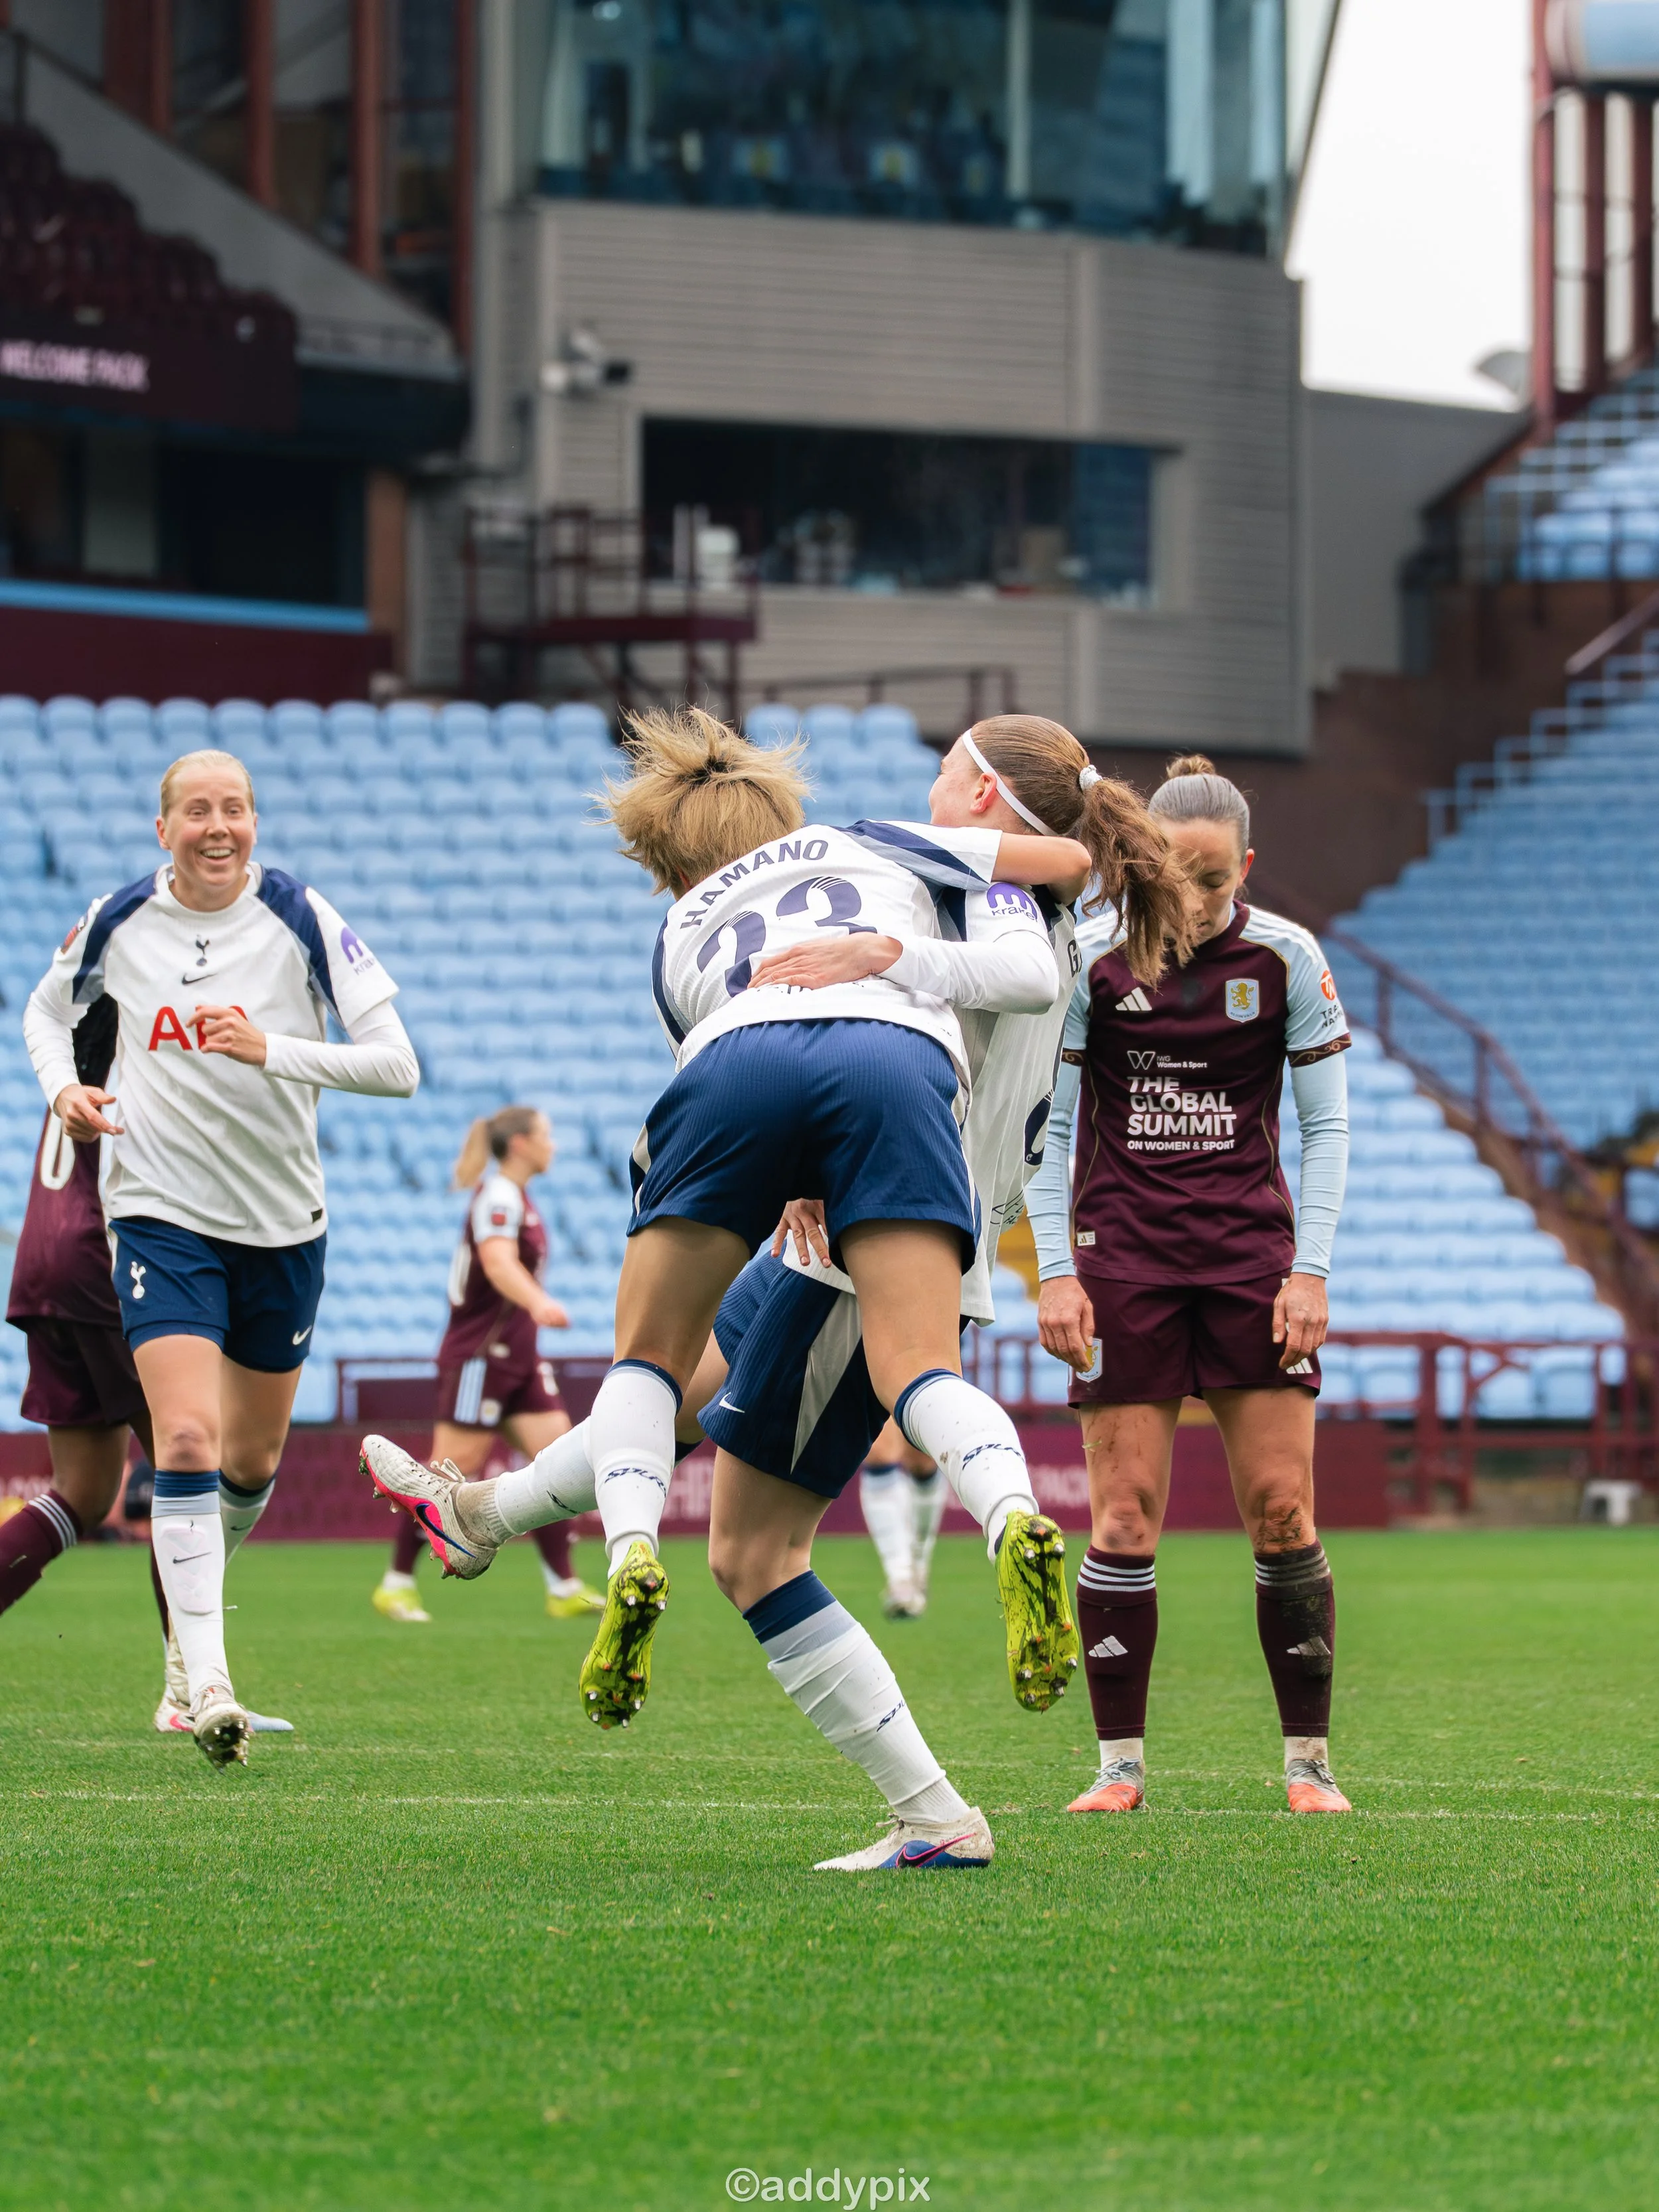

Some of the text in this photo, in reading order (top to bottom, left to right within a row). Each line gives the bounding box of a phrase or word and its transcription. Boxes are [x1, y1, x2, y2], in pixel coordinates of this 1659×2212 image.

[680, 840, 828, 928] HAMANO
[1127, 1076, 1181, 1092] THE
[1130, 1092, 1232, 1113] GLOBAL
[1127, 1114, 1237, 1136] SUMMIT
[1127, 1140, 1143, 1150] ON
[1144, 1141, 1190, 1151] WOMEN
[1202, 1140, 1235, 1150] SPORT
